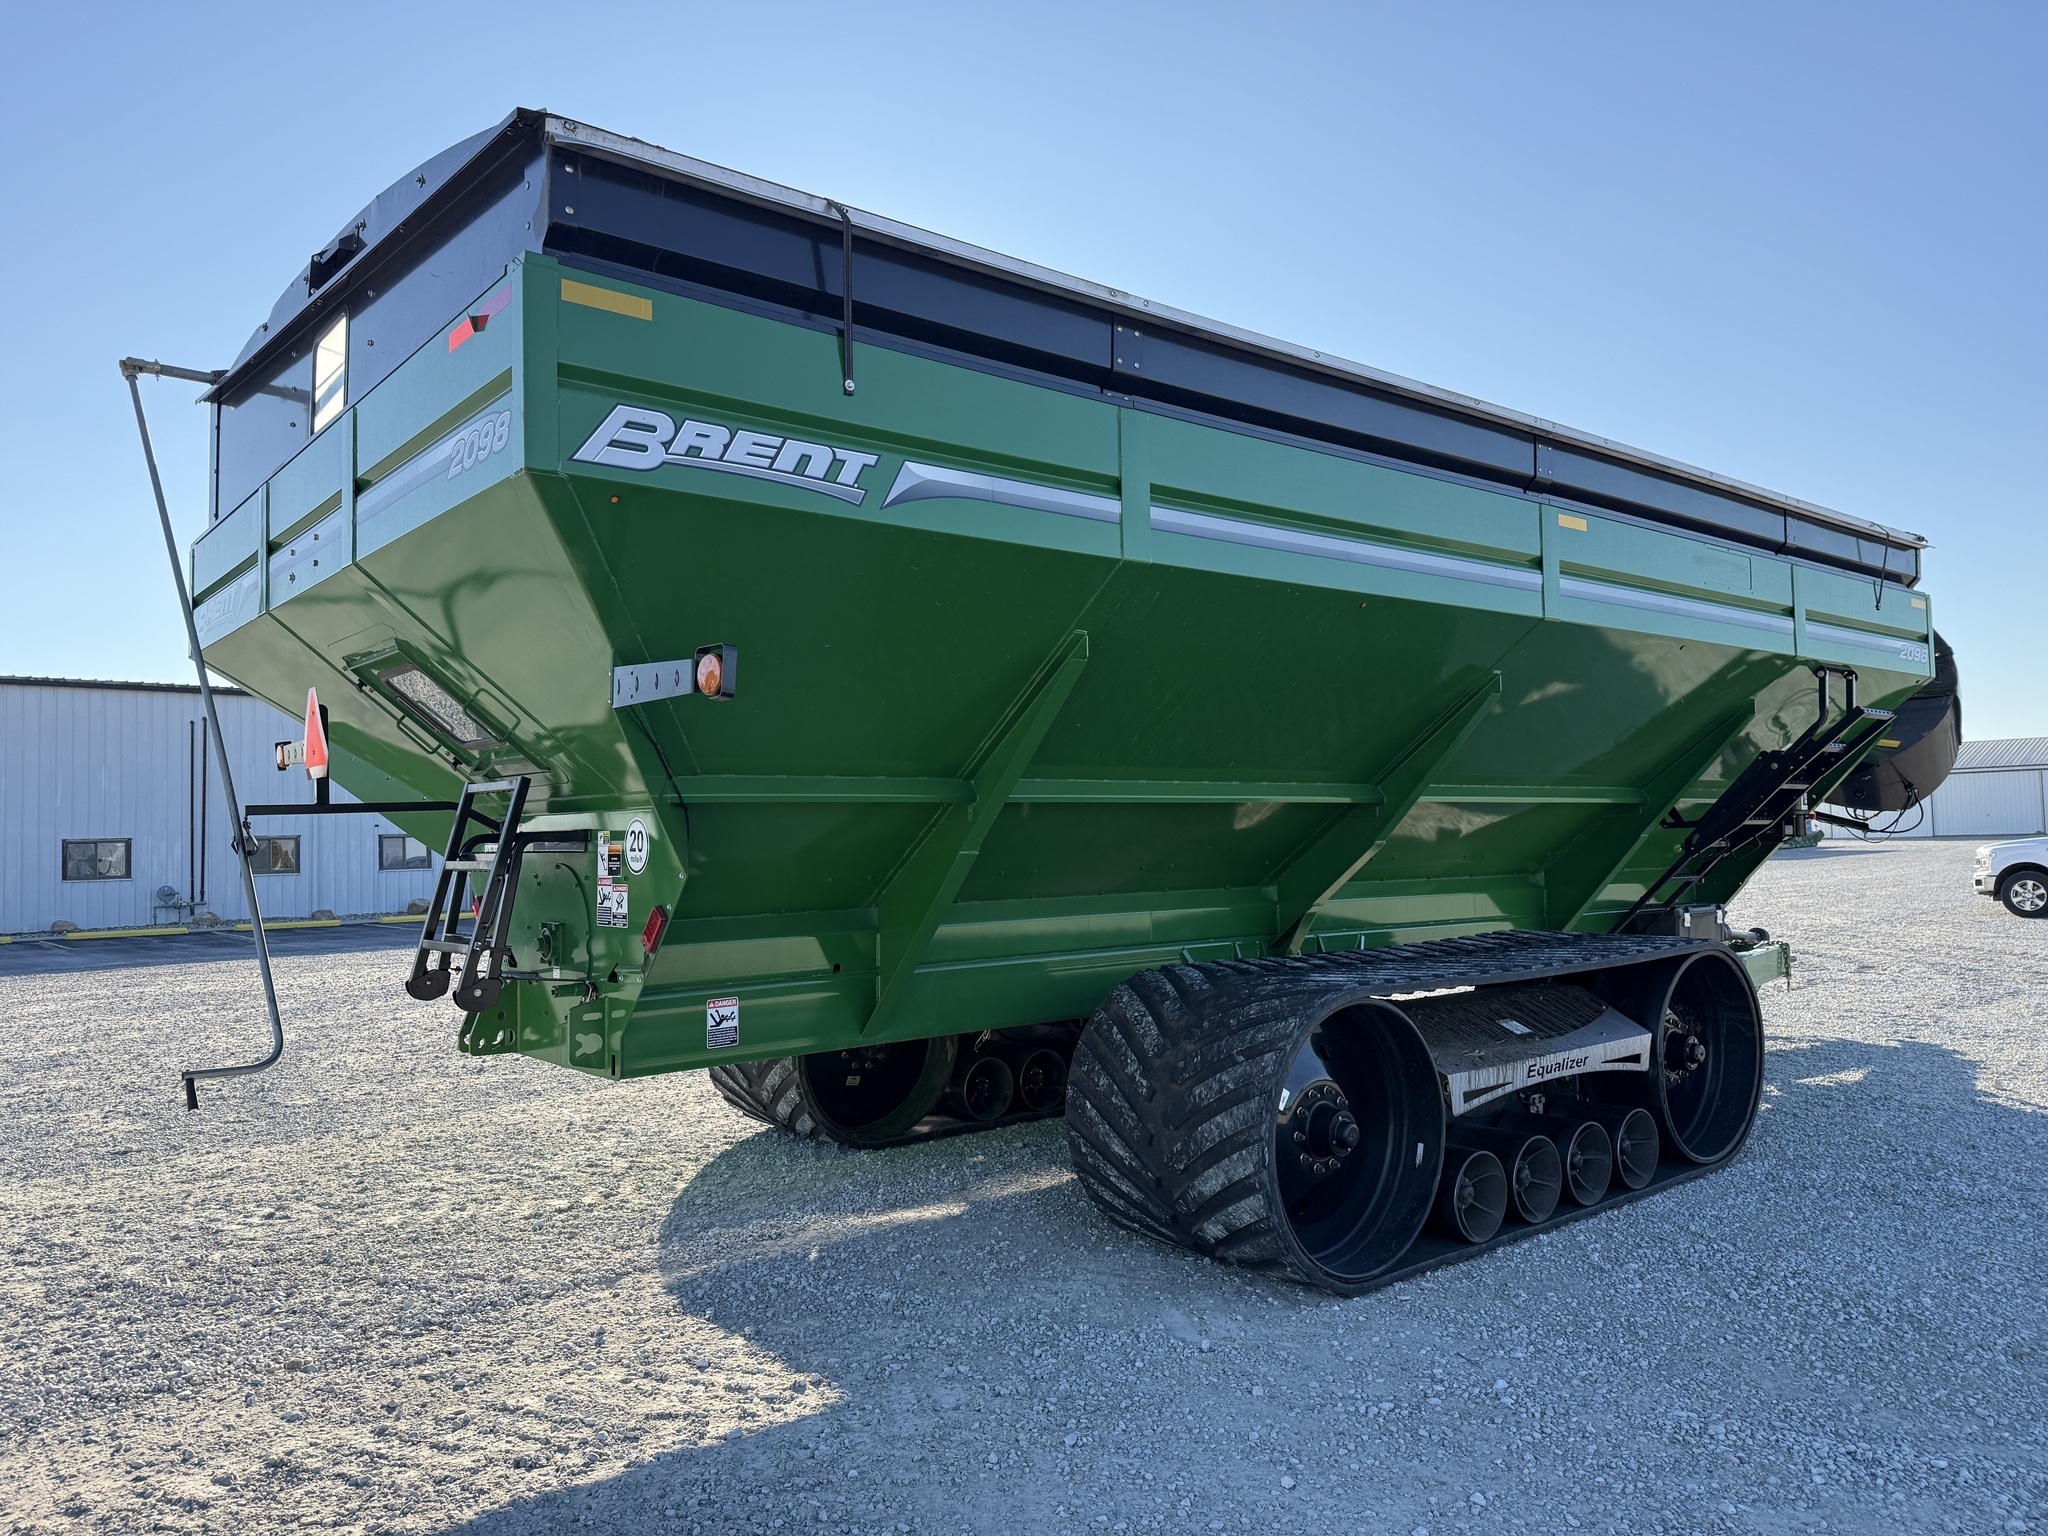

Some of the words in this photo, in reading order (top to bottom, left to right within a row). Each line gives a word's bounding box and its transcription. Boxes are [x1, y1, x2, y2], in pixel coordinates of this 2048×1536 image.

[448, 410, 511, 480] 2098
[570, 403, 880, 494] BRENT
[1900, 645, 1929, 663] 2098
[629, 830, 644, 852] 20
[714, 999, 737, 1007] DANGER
[1527, 1056, 1589, 1079] Equalizer
